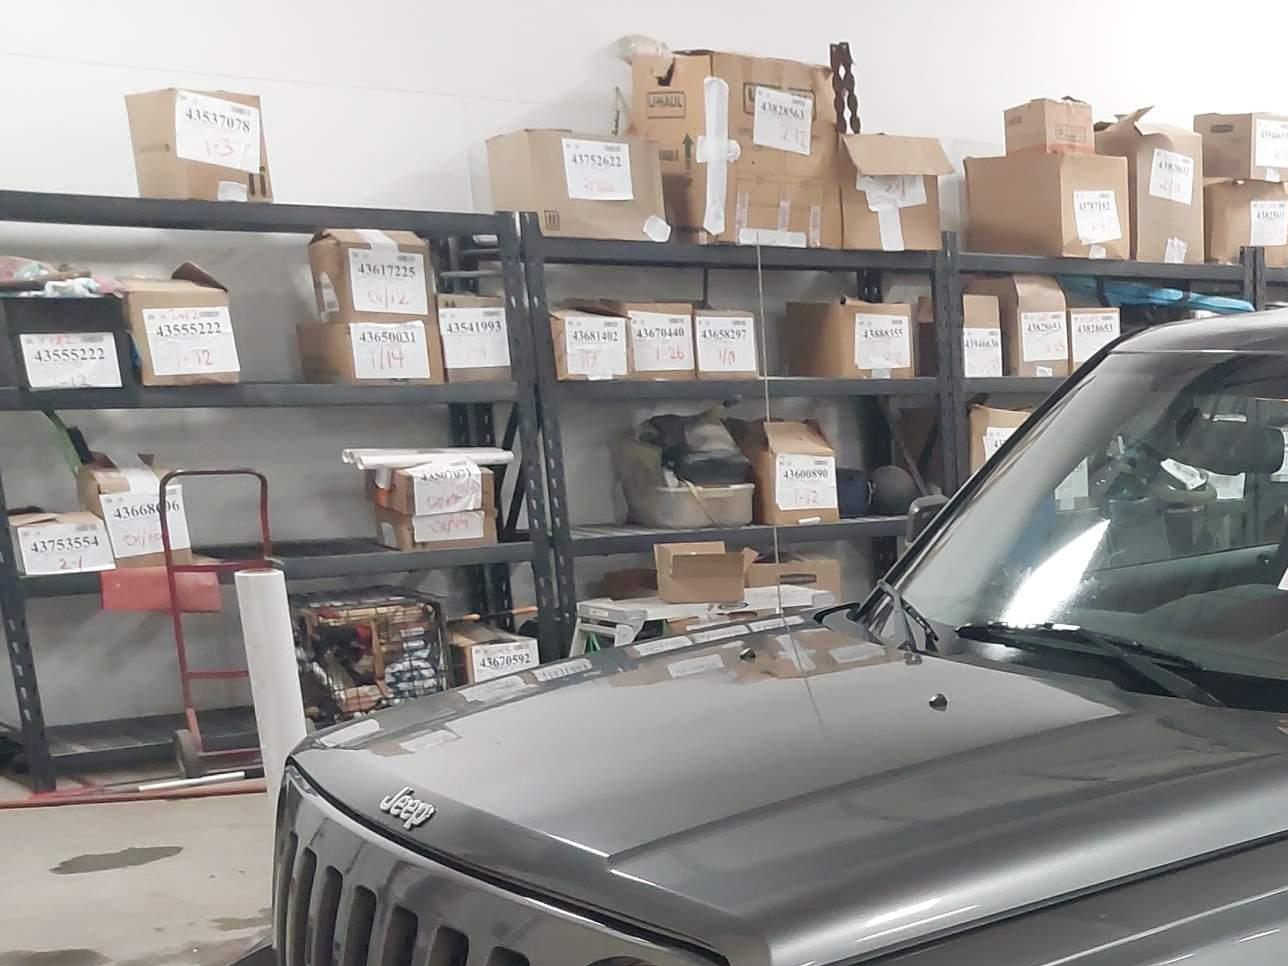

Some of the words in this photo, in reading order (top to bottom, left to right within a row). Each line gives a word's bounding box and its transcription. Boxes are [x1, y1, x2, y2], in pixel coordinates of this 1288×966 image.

[185, 107, 250, 132] 43537078
[572, 153, 622, 167] 43752622
[358, 263, 416, 278] 43617225
[156, 321, 223, 337] 43555222
[447, 320, 502, 334] 43541993
[637, 327, 685, 339] 43670440
[702, 329, 747, 340] 43658297
[359, 331, 416, 344] 43650031
[573, 330, 619, 342] 43681402
[34, 347, 105, 363] 43555222
[31, 535, 100, 553] 43753554
[480, 653, 532, 669] 43670592
[379, 786, 435, 829] Jeep
